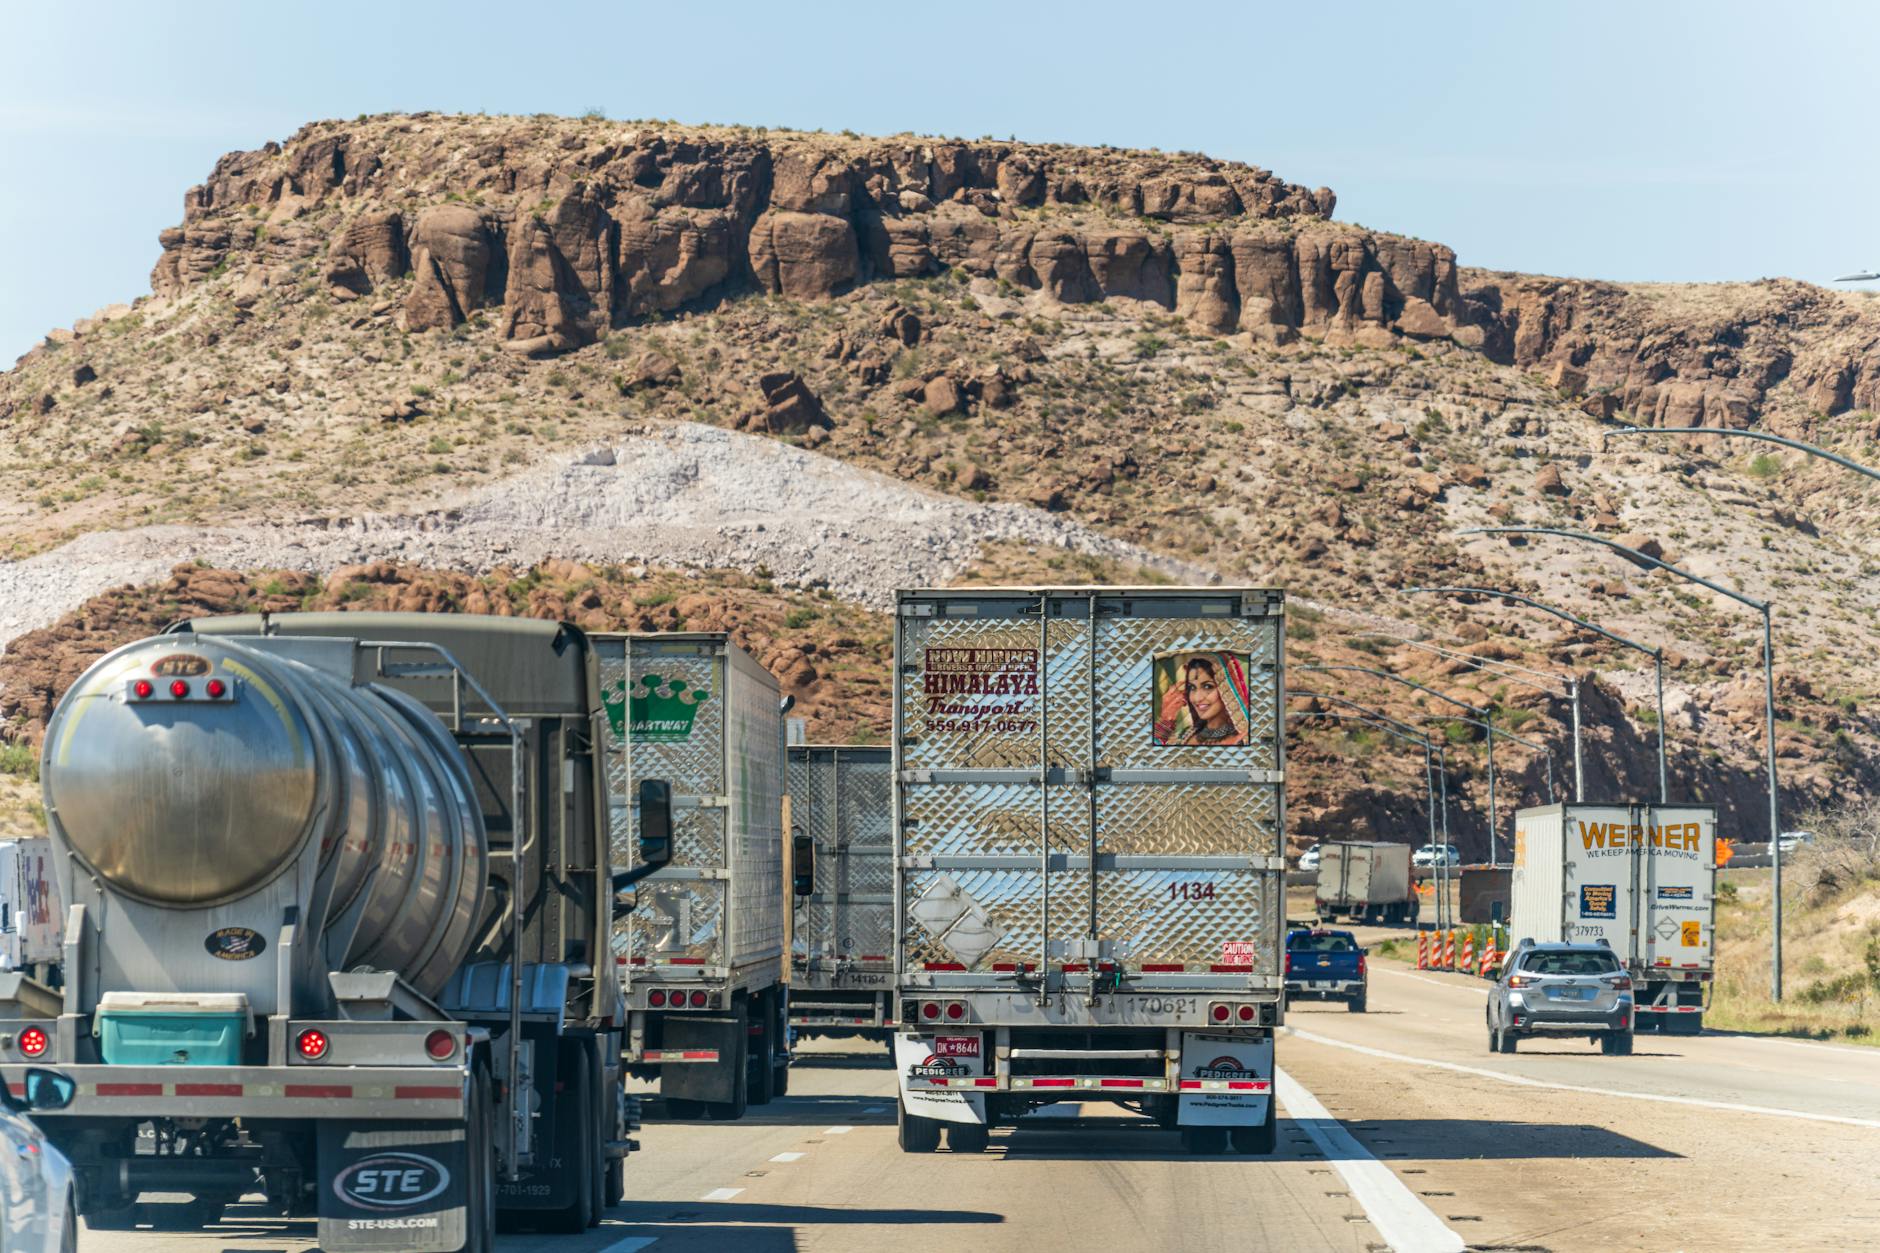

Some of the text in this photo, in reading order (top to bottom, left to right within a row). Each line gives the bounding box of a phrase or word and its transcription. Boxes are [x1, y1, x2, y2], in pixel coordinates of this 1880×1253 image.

[929, 649, 1035, 662] NOW HIRING
[925, 674, 1039, 694] HIMALAYA
[926, 697, 1023, 720] Transport
[926, 720, 1037, 733] 559.917.0677
[1579, 821, 1700, 852] WERNER
[1587, 848, 1698, 861] WE KEEP AMERICA MOVING
[1168, 881, 1215, 900] 1134
[1575, 925, 1603, 937] 379733
[1223, 943, 1254, 954] CAUTION
[1127, 998, 1197, 1014] 170621
[937, 1043, 978, 1054] DK 8644
[915, 1067, 965, 1076] PEDIGREE
[1200, 1069, 1252, 1078] PEDIGREE
[354, 1169, 425, 1193] STE
[348, 1218, 437, 1230] STE-USA.COM
